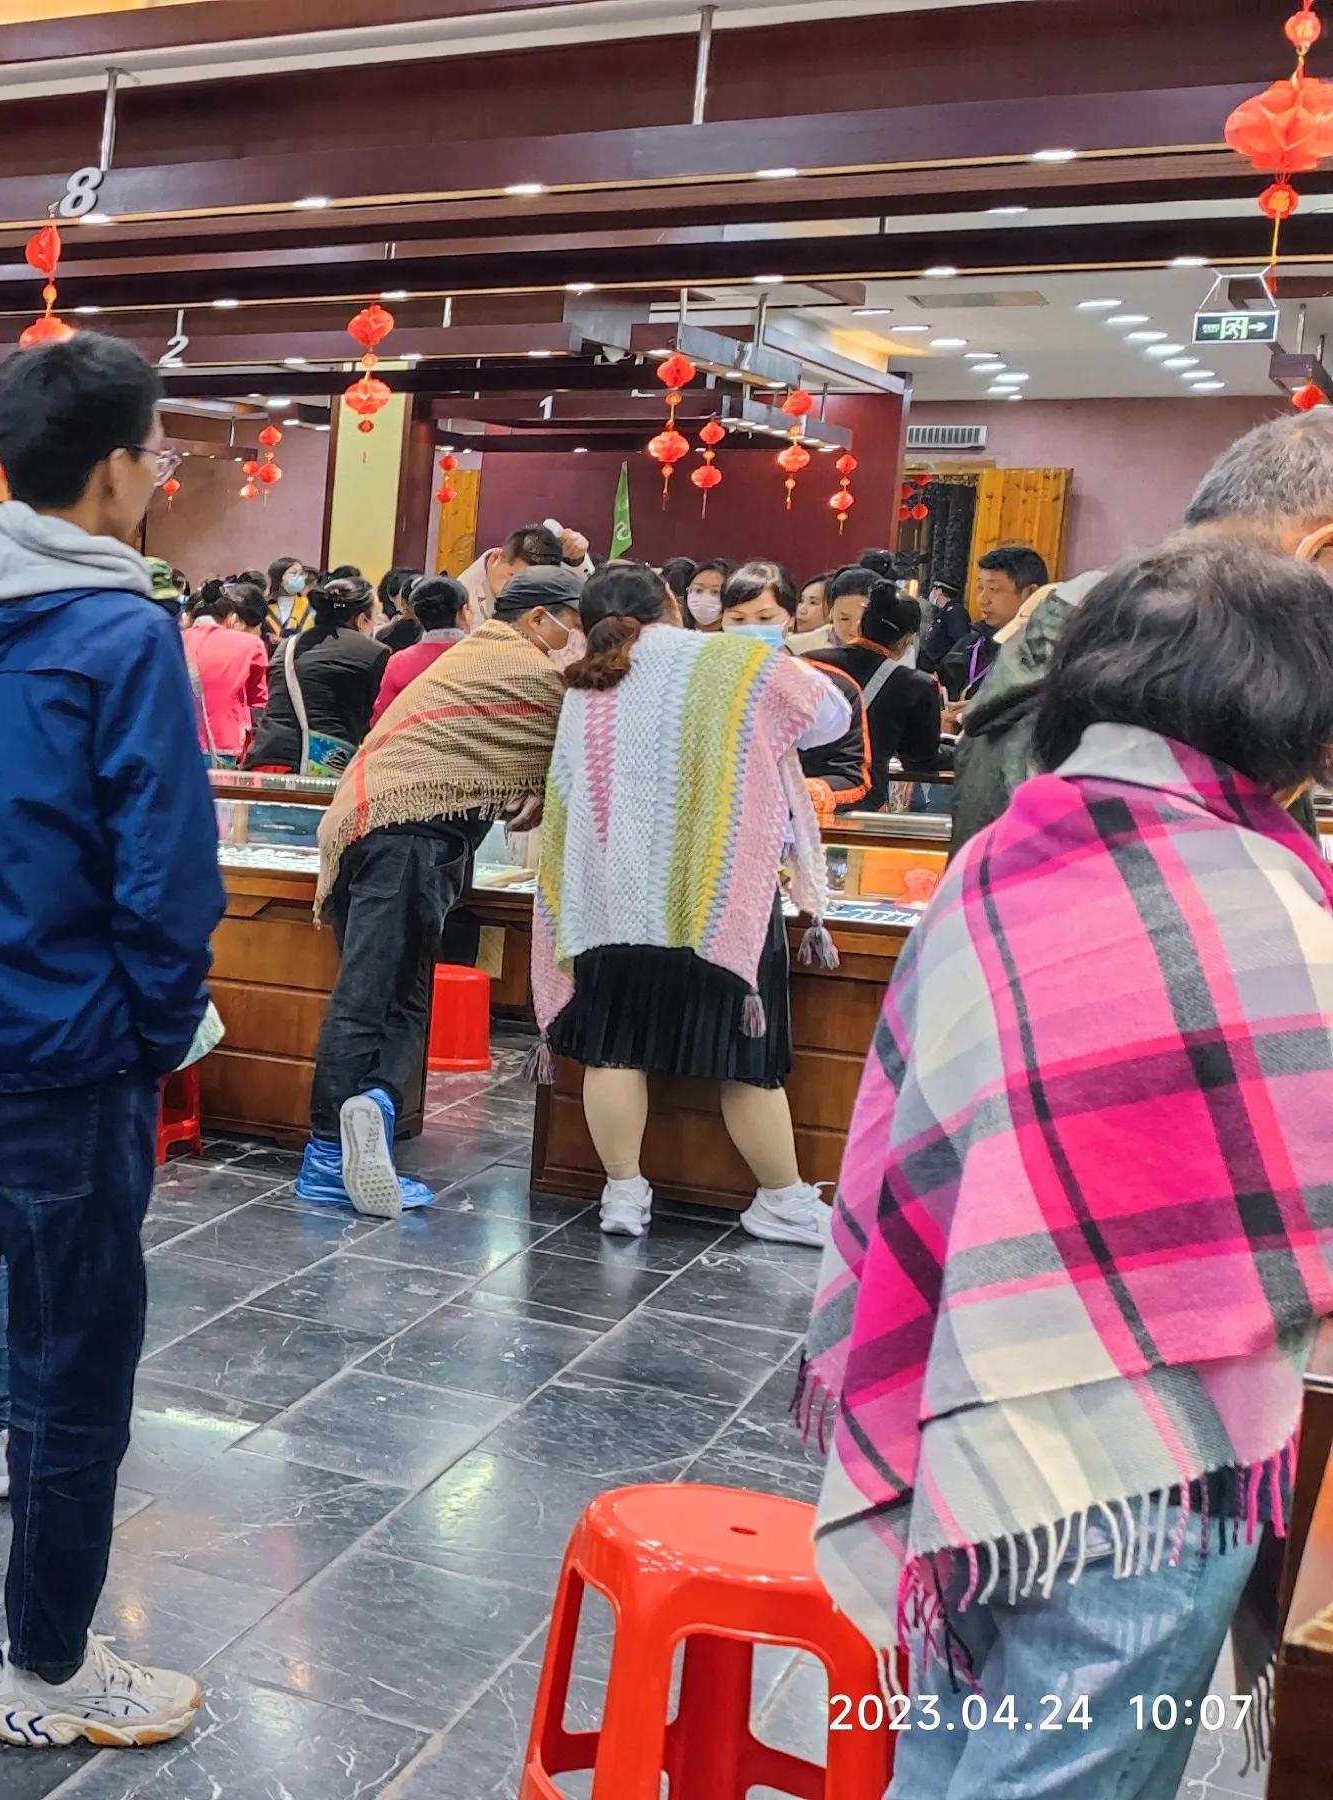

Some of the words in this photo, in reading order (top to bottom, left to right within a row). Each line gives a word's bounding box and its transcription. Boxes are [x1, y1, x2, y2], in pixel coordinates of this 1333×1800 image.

[59, 167, 102, 217] 8
[159, 336, 189, 365] 2
[539, 395, 554, 420] 1
